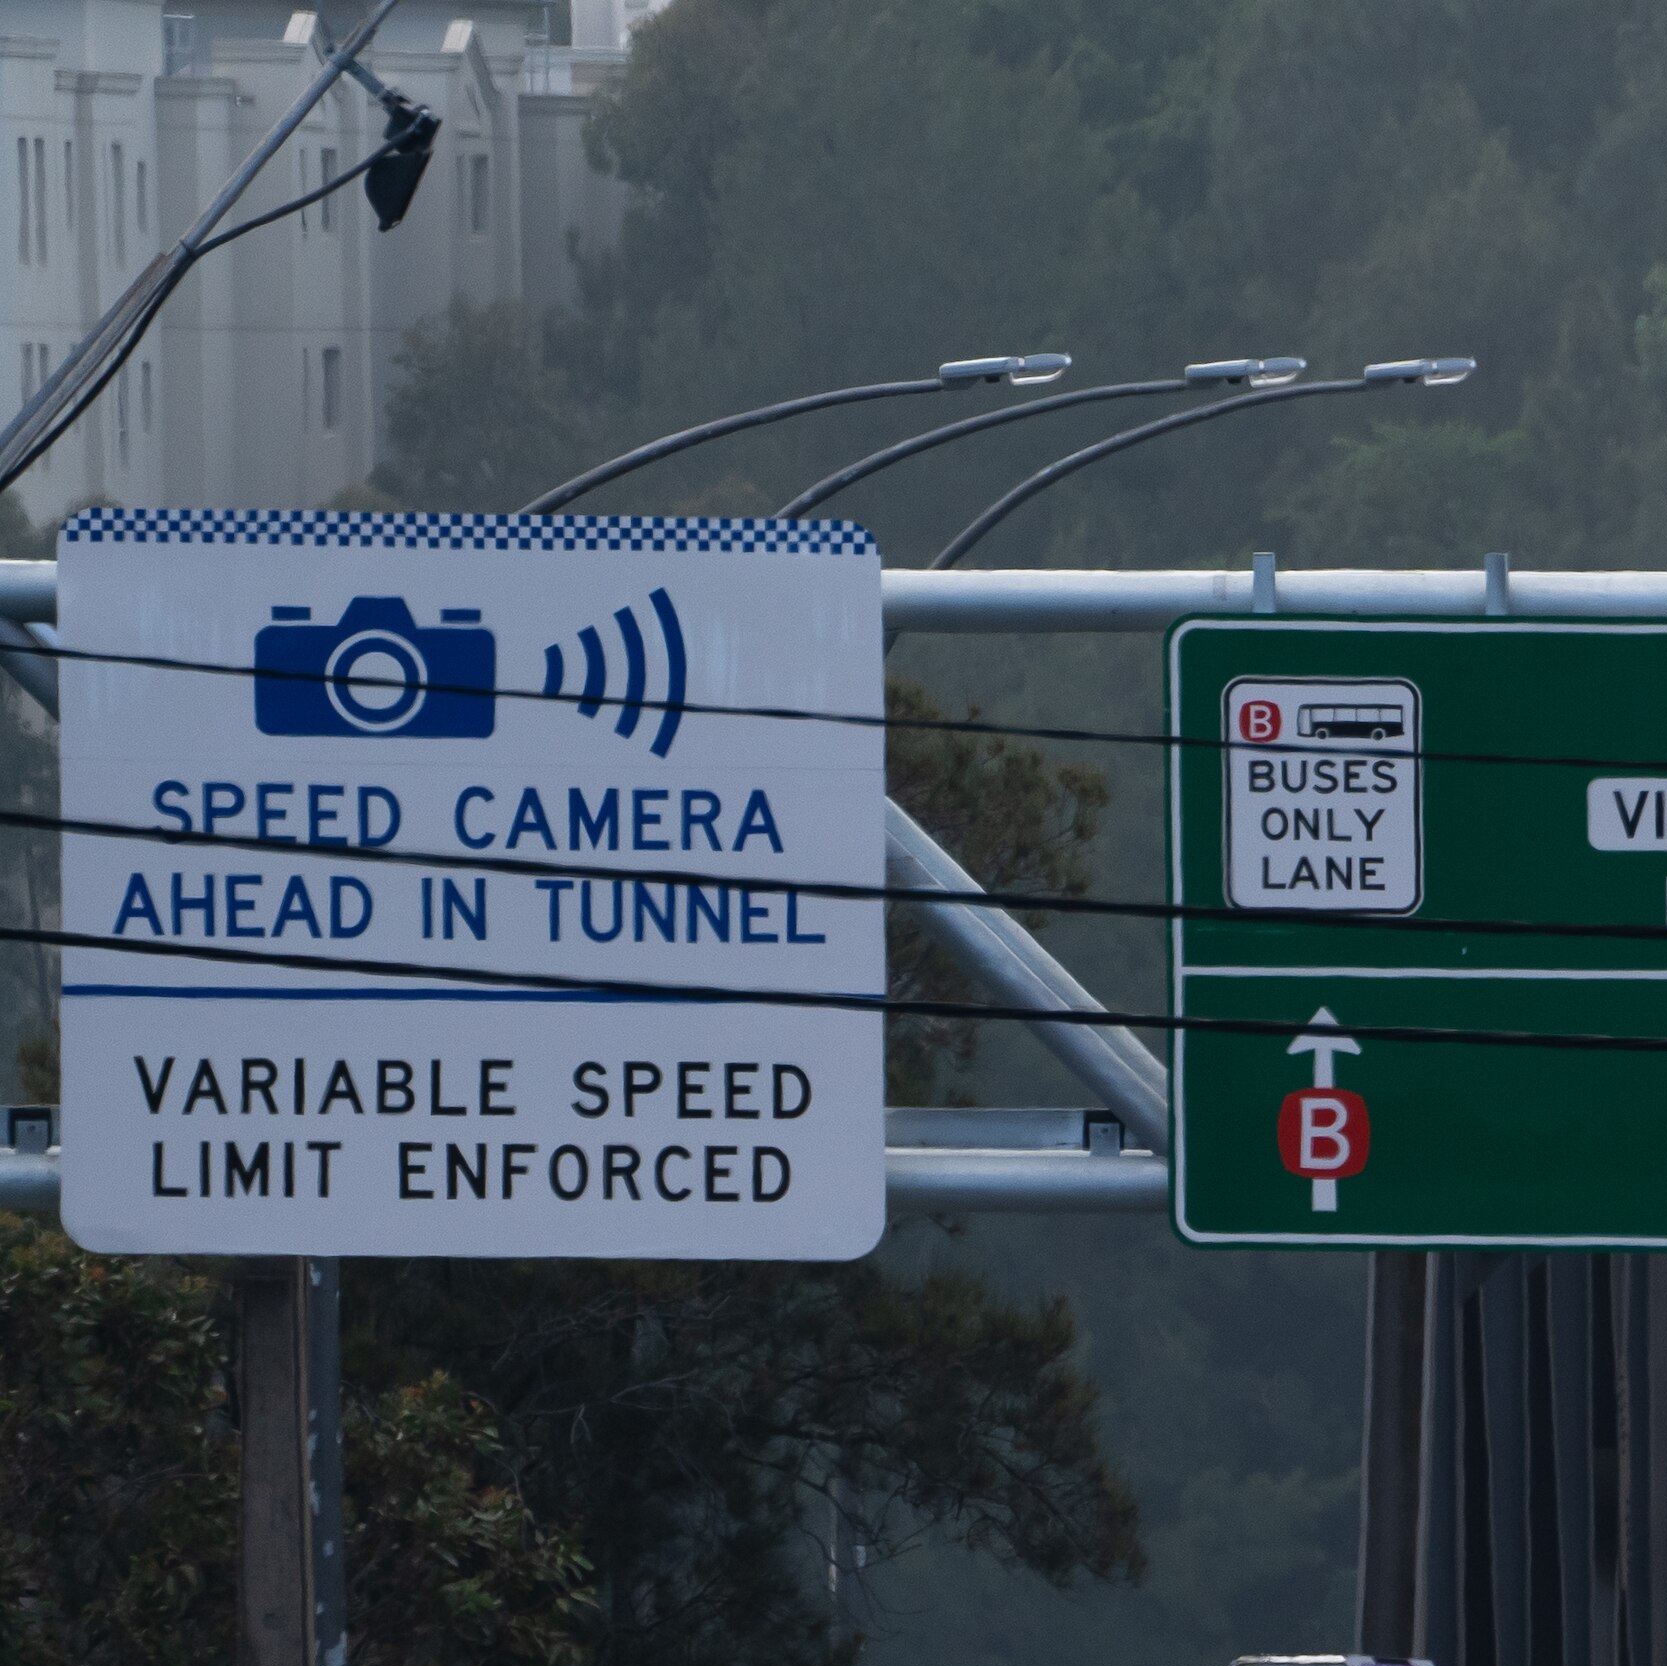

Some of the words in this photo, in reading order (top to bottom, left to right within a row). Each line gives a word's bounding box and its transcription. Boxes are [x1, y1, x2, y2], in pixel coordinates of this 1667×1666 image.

[1250, 702, 1274, 739] B
[1247, 759, 1399, 796] BUSES
[151, 780, 403, 850] SPEED
[453, 786, 785, 855] CAMERA
[1260, 807, 1387, 843] ONLY
[1260, 855, 1387, 892] LANE
[112, 873, 375, 941] AHEAD
[421, 876, 488, 942] IN
[535, 877, 828, 946] TUNNEL
[133, 1055, 517, 1117] VARIABLE
[570, 1061, 814, 1119] SPEED
[1297, 1097, 1351, 1172] B
[151, 1141, 343, 1199] LIMIT
[398, 1142, 794, 1204] ENFORCED
